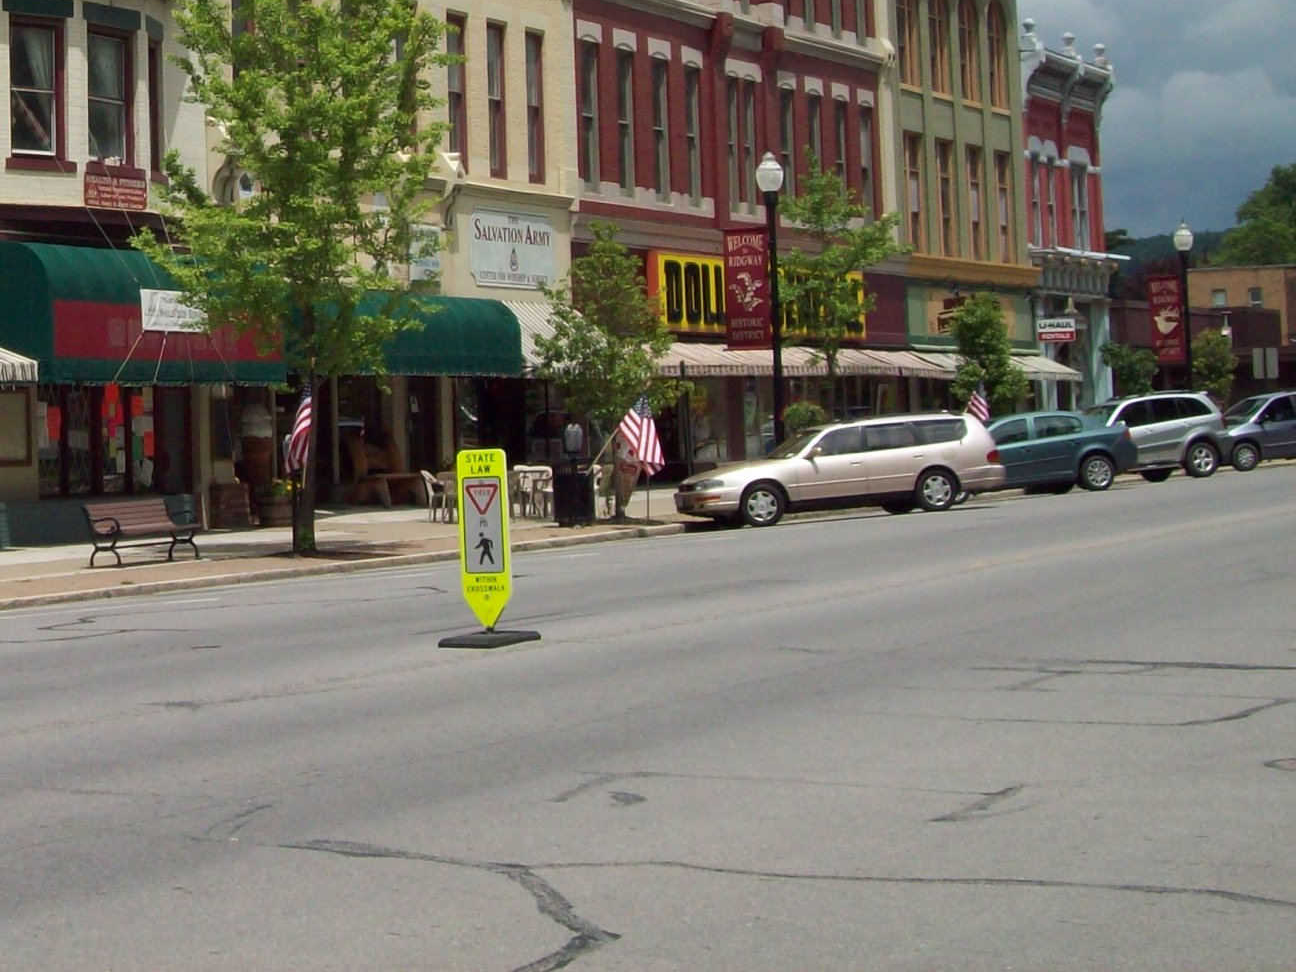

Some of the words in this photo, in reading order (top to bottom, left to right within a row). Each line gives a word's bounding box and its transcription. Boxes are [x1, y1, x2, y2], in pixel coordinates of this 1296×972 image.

[474, 218, 523, 244] SALVATION
[525, 224, 551, 246] ARMY
[727, 234, 763, 252] WELCOME
[729, 255, 763, 267] RIDGWAY
[664, 259, 725, 326] DOLL
[731, 318, 764, 328] HISTORIC
[1038, 321, 1073, 330] U-HAUL
[732, 330, 764, 341] DISTRICT
[1041, 332, 1070, 340] RENTALS
[465, 453, 495, 463] STATE
[471, 465, 491, 474] LAW
